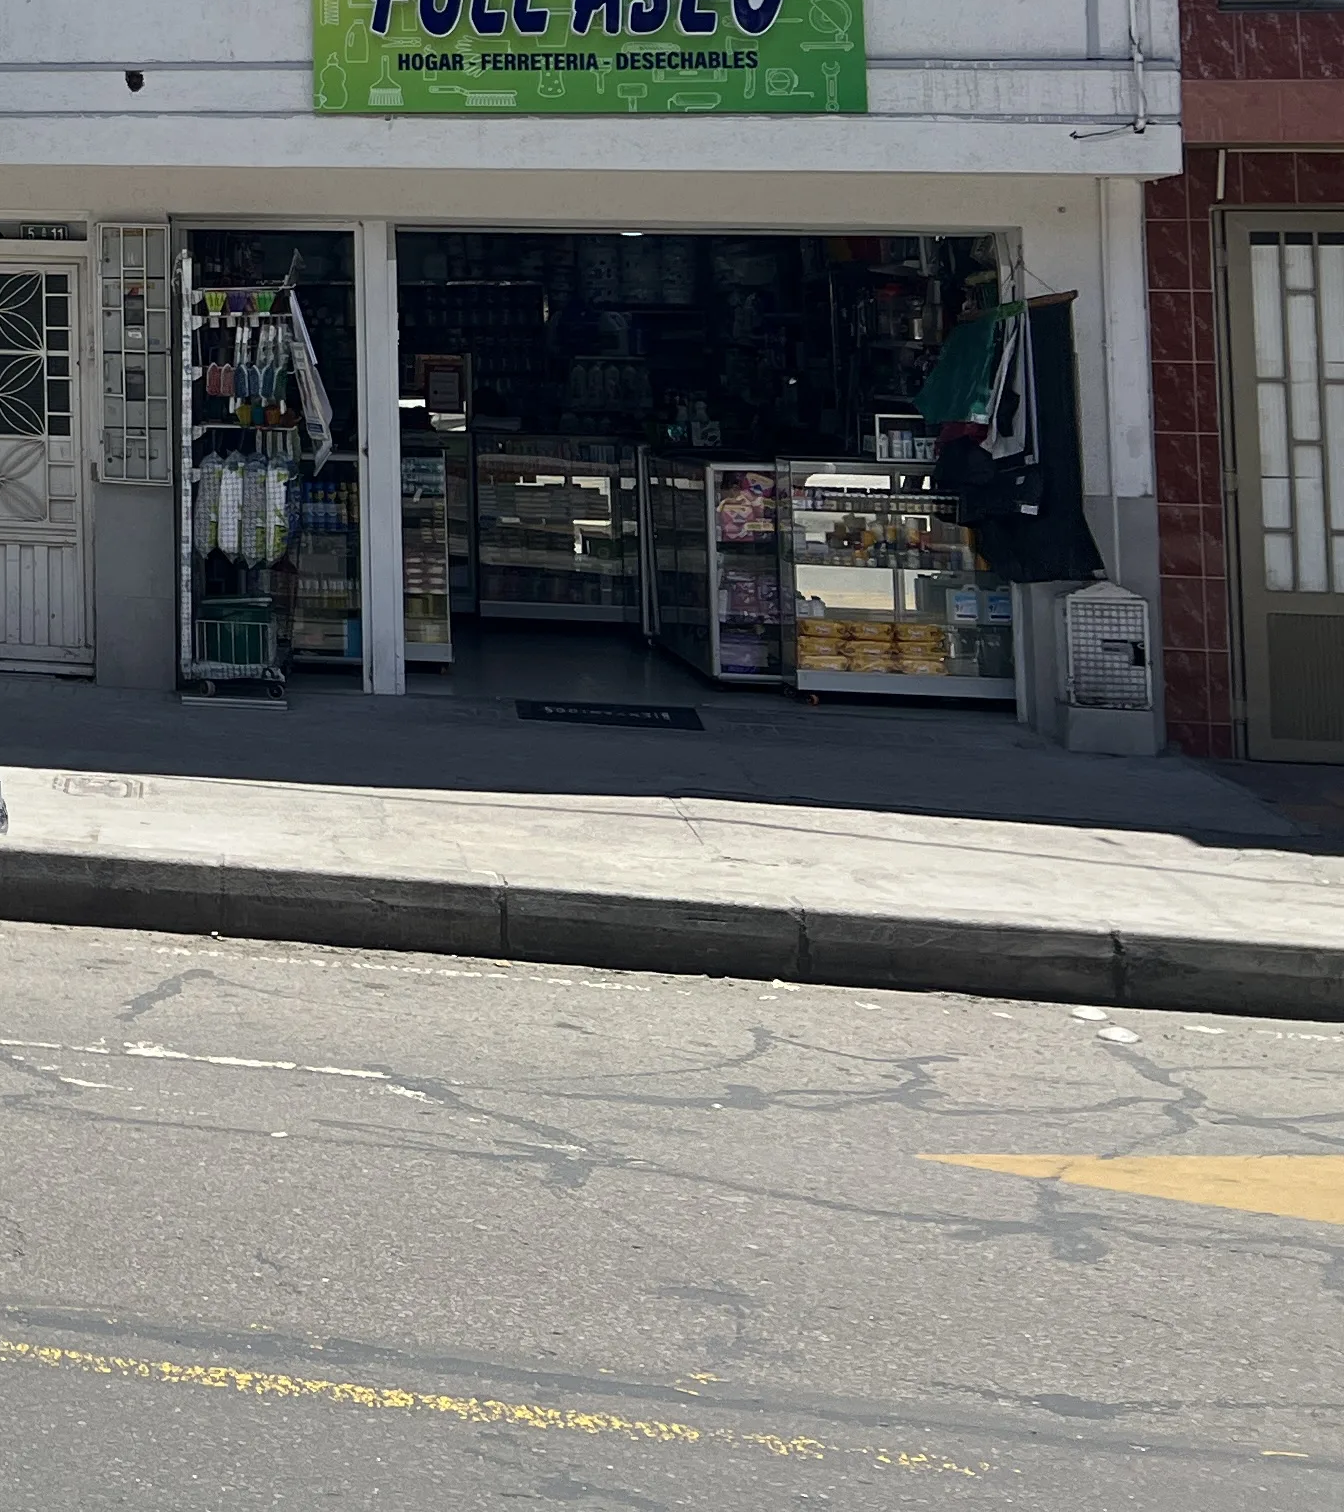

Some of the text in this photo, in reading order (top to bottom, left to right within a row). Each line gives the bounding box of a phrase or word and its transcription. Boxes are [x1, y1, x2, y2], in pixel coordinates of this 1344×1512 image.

[397, 53, 464, 71] HOGAR
[481, 52, 599, 71] FERRETERIA
[616, 50, 759, 70] DESECHABLES
